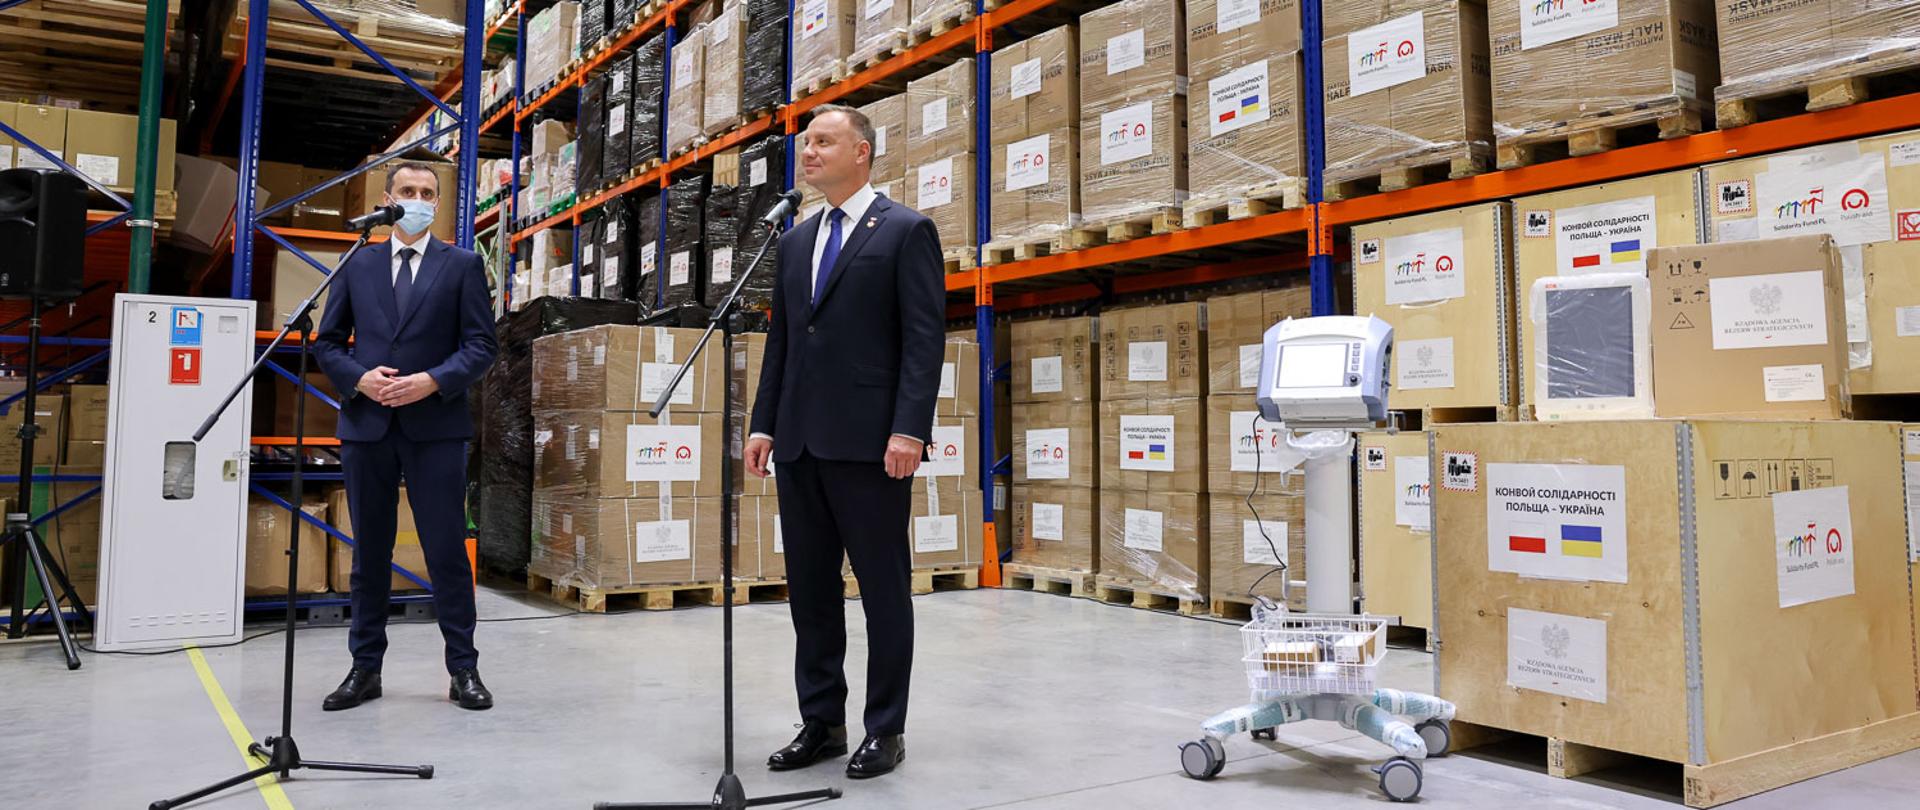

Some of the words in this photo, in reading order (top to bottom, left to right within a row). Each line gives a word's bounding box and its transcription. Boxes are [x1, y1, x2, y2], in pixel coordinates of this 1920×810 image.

[1630, 21, 1664, 39] HALF
[1426, 62, 1452, 76] ASK
[1562, 220, 1592, 232] КОНВОЙ
[1593, 213, 1649, 227] СОЛІДАРНОСТІ
[1570, 230, 1602, 241] ПОЛЬЩА
[1609, 225, 1642, 237] УКРАЇНА
[148, 310, 157, 324] 2
[1495, 485, 1537, 499] КОНВОЙ
[1537, 489, 1616, 503] СОЛІДАРНОСТІ
[1506, 501, 1549, 514] ПОЛЬЩА
[1559, 504, 1605, 517] УКРАЇНА
